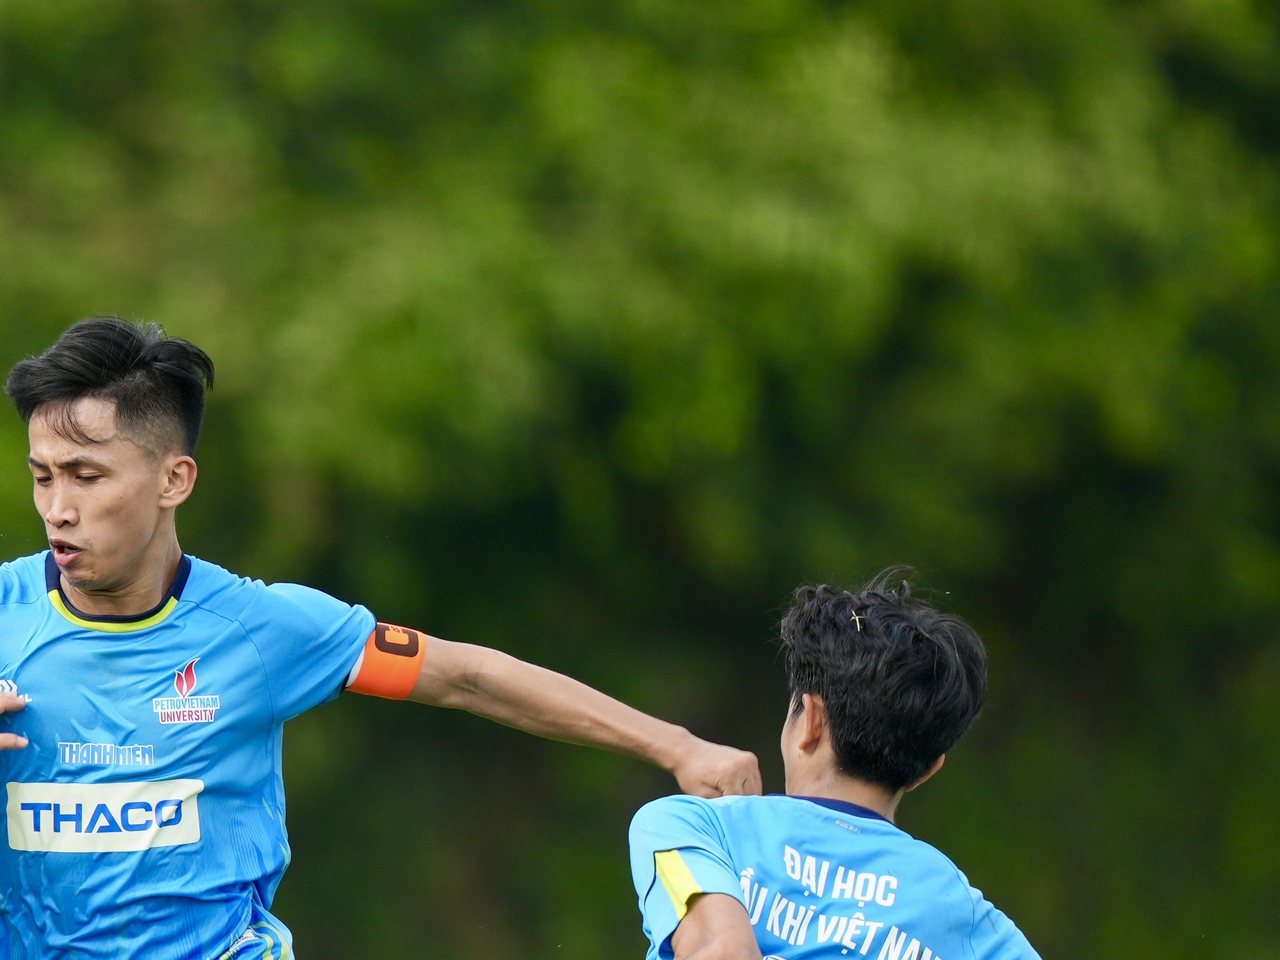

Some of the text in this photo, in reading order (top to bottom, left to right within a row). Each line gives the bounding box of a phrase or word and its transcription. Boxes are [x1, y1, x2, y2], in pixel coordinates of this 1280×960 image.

[154, 697, 219, 710] PETROVIETNAM
[160, 709, 214, 722] UNIVERSITY
[58, 743, 115, 765] THANH
[21, 799, 183, 834] THACO
[783, 845, 898, 908] ĐẠI HỌC
[766, 892, 817, 946] KHÍ
[817, 911, 884, 956] VIỆT
